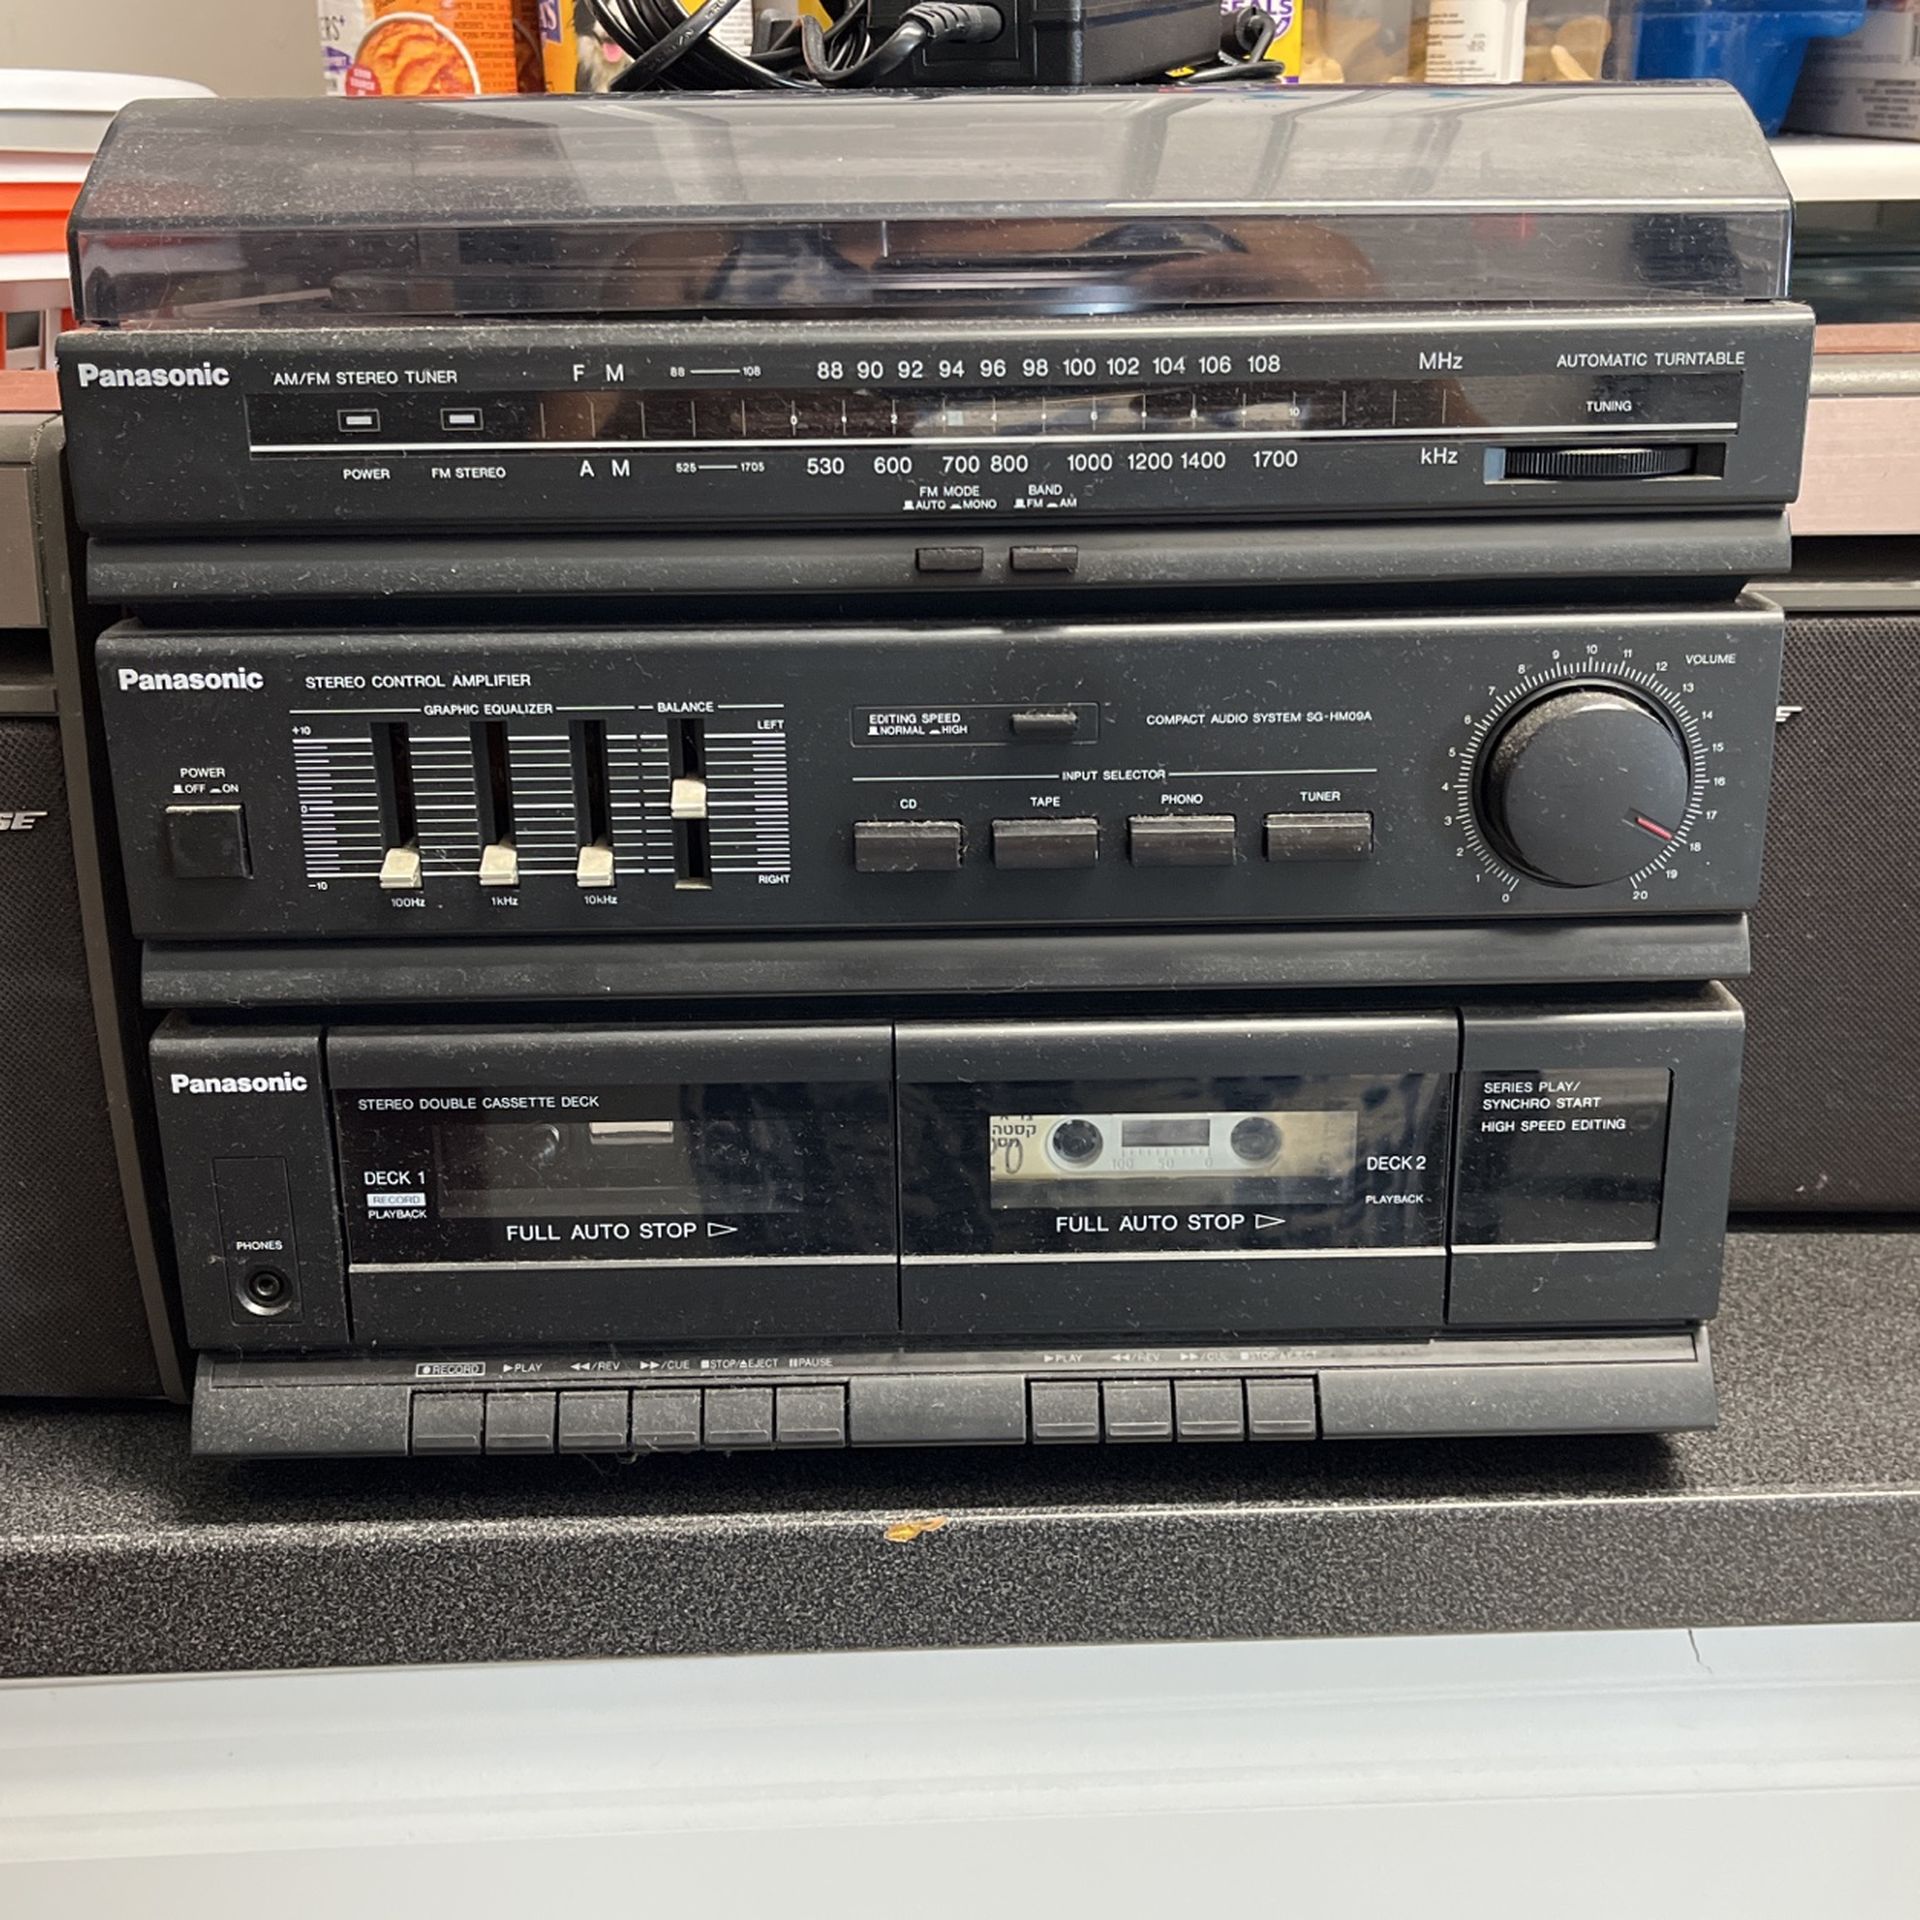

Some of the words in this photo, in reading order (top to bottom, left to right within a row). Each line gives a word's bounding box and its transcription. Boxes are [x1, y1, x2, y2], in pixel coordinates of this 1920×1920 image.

[1418, 352, 1463, 371] MHz
[1556, 352, 1647, 369] AUTOMATIC
[1654, 350, 1745, 367] TURNTABLE
[669, 365, 687, 378] 88
[742, 364, 761, 377] 108
[816, 360, 844, 379] 88
[856, 360, 884, 379] 90
[897, 360, 924, 379] 92
[938, 360, 965, 379] 94
[979, 360, 1007, 379] 96
[1022, 360, 1049, 379] 98
[1062, 358, 1097, 379] 100
[1106, 358, 1140, 379] 102
[1152, 358, 1187, 379] 104
[1198, 358, 1232, 379] 106
[1247, 358, 1282, 379] 108
[78, 362, 230, 388] Panasonic
[273, 370, 331, 386] AM/FM
[335, 370, 399, 386] STEREO
[404, 370, 458, 386] TUNER
[1586, 400, 1633, 413] TUNING
[807, 457, 845, 475] 530
[874, 456, 912, 475] 600
[943, 455, 980, 473] 700
[990, 454, 1028, 473] 800
[1067, 453, 1113, 471] 1000
[1127, 452, 1173, 471] 1200
[1180, 451, 1226, 470] 1400
[1252, 450, 1298, 468] 1700
[1420, 448, 1458, 465] kHz
[431, 466, 452, 479] FM
[456, 466, 506, 480] STEREO
[675, 462, 697, 473] 525
[740, 461, 765, 472] 1705
[342, 467, 390, 480] POWER
[919, 487, 939, 498] FM
[943, 485, 980, 497] MODE
[1028, 484, 1063, 496] BAND
[916, 500, 946, 511] AUTO
[963, 499, 997, 511] MONO
[1027, 498, 1043, 510] FM
[1059, 498, 1077, 509] AM
[1552, 650, 1560, 661] 9
[1586, 644, 1598, 656] 10
[1623, 650, 1633, 659] 11
[1685, 654, 1737, 665] VOLUME
[1518, 664, 1526, 675] 8
[1656, 662, 1668, 673] 12
[118, 667, 264, 691] Panasonic
[305, 676, 366, 688] STEREO
[371, 674, 445, 688] CONTROL
[452, 673, 532, 687] AMPLIFIER
[1488, 686, 1496, 697] 7
[1683, 682, 1694, 693] 13
[424, 704, 479, 715] GRAPHIC
[484, 703, 553, 715] EQUALIZER
[657, 701, 714, 712] BALANCE
[869, 712, 917, 724] EDITING
[921, 712, 961, 723] SPEED
[1146, 713, 1205, 725] COMPACT
[1210, 712, 1248, 724] AUDIO
[1252, 711, 1301, 723] SYSTEM
[1306, 709, 1373, 722] SG-HM09A
[1464, 714, 1472, 726] 6
[1702, 709, 1713, 720] 14
[292, 724, 311, 735] +10
[757, 720, 784, 730] LEFT
[880, 725, 926, 736] NORMAL
[941, 724, 969, 735] HIGH
[1449, 747, 1456, 758] 5
[1712, 742, 1724, 753] 15
[180, 768, 226, 778] POWER
[1062, 770, 1099, 781] INPUT
[1103, 769, 1166, 781] SELECTOR
[1441, 781, 1449, 792] 4
[1714, 776, 1726, 787] 16
[185, 784, 206, 793] OFF
[222, 783, 239, 793] ON
[1030, 796, 1060, 808] TAPE
[1161, 793, 1203, 805] PHONO
[1300, 791, 1341, 802] TUNER
[900, 798, 917, 810] CD
[1444, 815, 1452, 826] 3
[1706, 810, 1717, 821] 17
[1456, 847, 1464, 858] 2
[1690, 841, 1701, 852] 18
[758, 874, 791, 885] RIGHT
[1665, 869, 1678, 880] 19
[491, 896, 519, 906] 1kHz
[584, 895, 618, 905] 10kHz
[1502, 892, 1510, 903] 0
[1633, 890, 1648, 901] 20
[391, 898, 426, 907] 100Hz
[171, 1074, 307, 1093] Panasonic
[1484, 1082, 1533, 1093] SERIES
[1538, 1081, 1581, 1093] PLAY/
[358, 1099, 414, 1110] STEREO
[420, 1098, 477, 1110] DOUBLE
[482, 1097, 556, 1109] CASSETTE
[561, 1096, 599, 1108] DECK
[1483, 1098, 1552, 1110] SYNCHRO
[1556, 1097, 1600, 1108] START
[992, 1124, 1036, 1138] קסטה
[1482, 1120, 1516, 1132] HIGH
[1521, 1119, 1567, 1131] SPEED
[1572, 1118, 1626, 1130] EDITING
[1367, 1157, 1411, 1170] DECK
[1415, 1155, 1426, 1169] 2
[364, 1171, 411, 1185] DECK
[418, 1171, 425, 1184] 1
[372, 1195, 421, 1205] RECORD
[1366, 1194, 1424, 1204] PLAYBACK
[368, 1209, 427, 1219] PLAYBACK
[1056, 1214, 1109, 1233] FULL
[1119, 1213, 1178, 1231] AUTO
[1187, 1212, 1245, 1230] STOP
[507, 1224, 560, 1241] FULL
[571, 1223, 630, 1240] AUTO
[639, 1222, 697, 1239] STOP
[236, 1240, 283, 1251] PHONES
[514, 1362, 542, 1373] PLAY
[799, 1356, 833, 1367] PAUSE
[433, 1364, 480, 1375] RECORD
